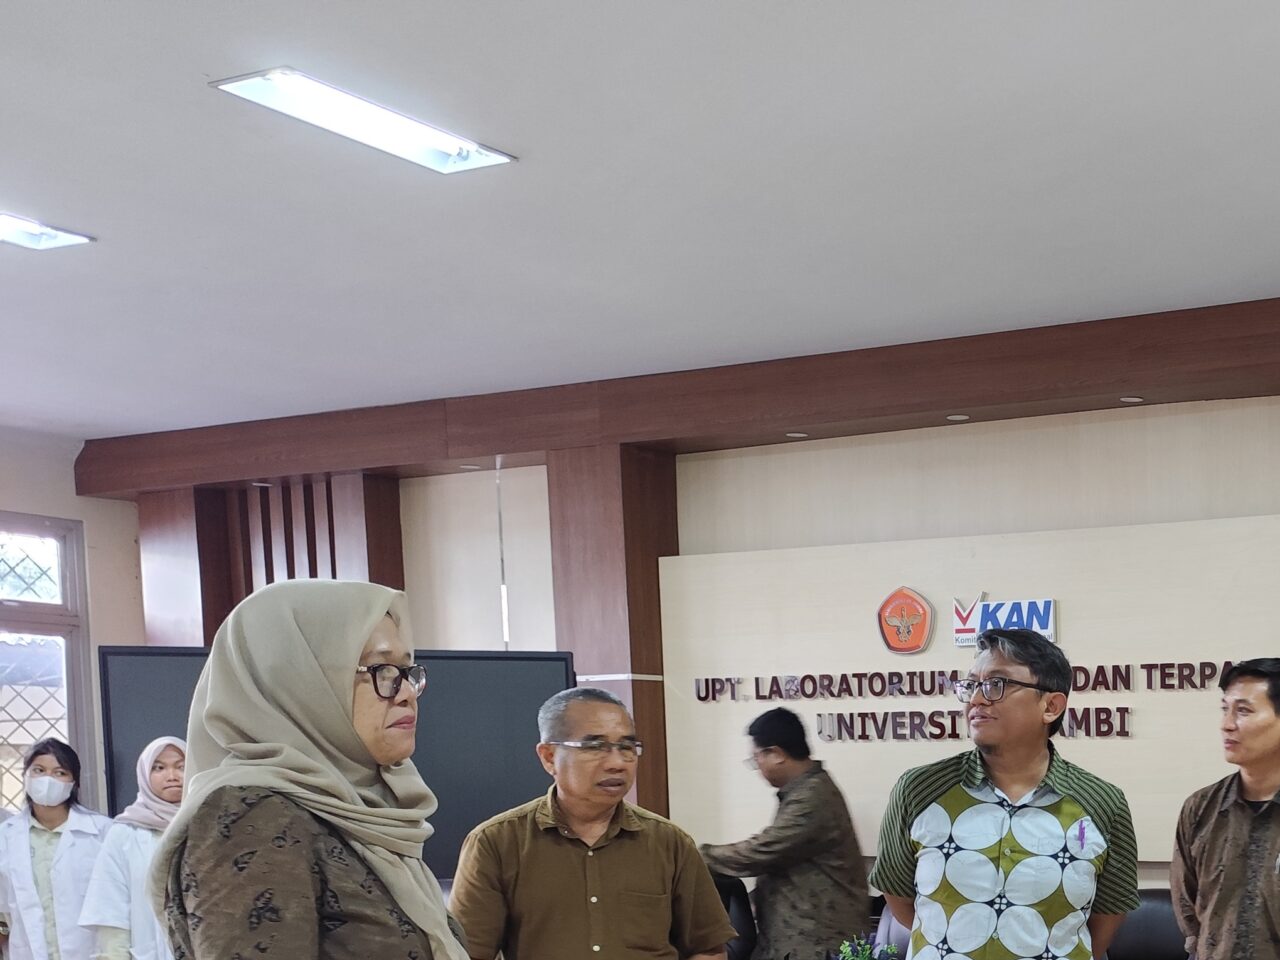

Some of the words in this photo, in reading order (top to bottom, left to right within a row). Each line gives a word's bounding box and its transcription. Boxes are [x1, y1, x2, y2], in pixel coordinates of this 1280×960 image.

[979, 600, 1052, 632] KAN
[955, 636, 977, 645] Komit
[754, 670, 958, 701] LABORATORIUM
[1072, 664, 1131, 692] DAN
[816, 710, 962, 742] UNIVERSI
